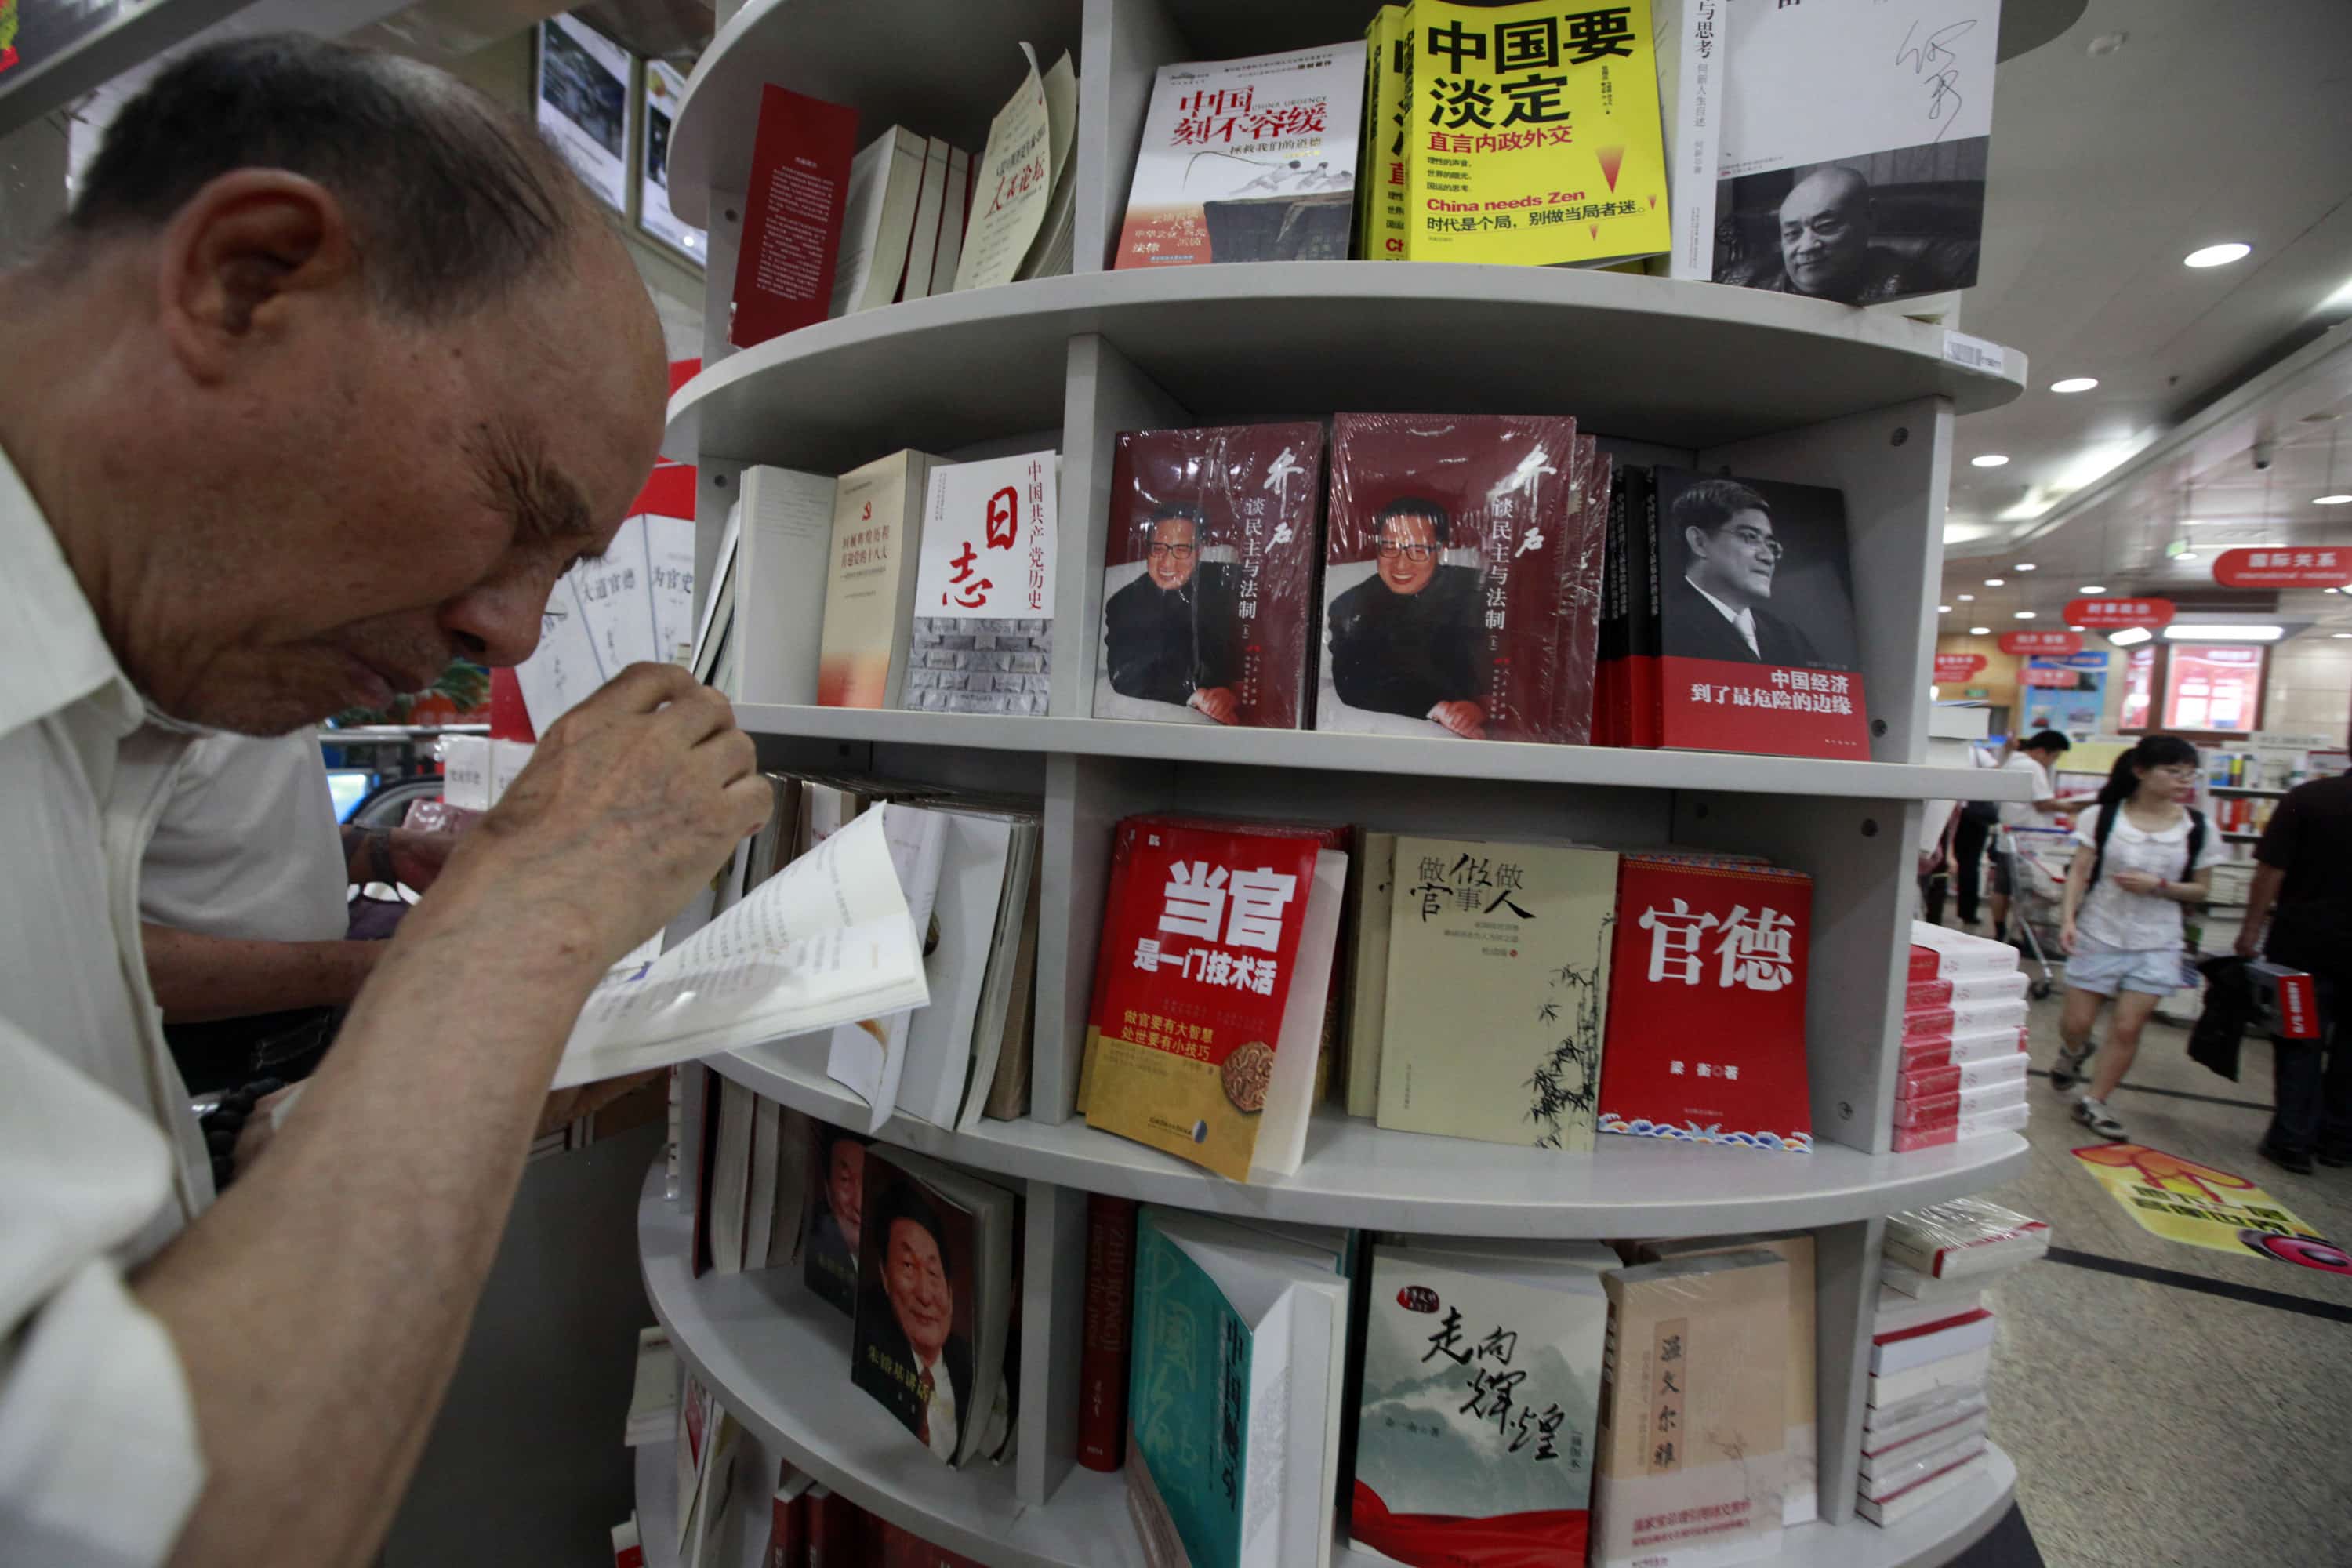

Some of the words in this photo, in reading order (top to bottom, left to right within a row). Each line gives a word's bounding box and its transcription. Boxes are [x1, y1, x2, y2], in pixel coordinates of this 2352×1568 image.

[1428, 8, 1635, 74] 中国要
[1169, 101, 1328, 147] 刻不容缓
[1179, 85, 1254, 118] 中国
[1429, 74, 1571, 129] 淡定
[1229, 137, 1322, 155] 拯救我们的道德
[1427, 125, 1573, 154] 直言内政外交
[1427, 198, 1479, 212] China
[1488, 194, 1543, 211] needs
[1548, 189, 1585, 205] Zen
[1427, 199, 1646, 233] 时代是个局，别做当局者迷。
[942, 485, 1018, 609] 日志
[1029, 459, 1044, 610] 中国共产党历史
[1238, 498, 1265, 619] 谈民主与法制
[1485, 499, 1514, 630] 谈民主与法制
[1690, 683, 1853, 715] 到了最危险的边缘
[1771, 669, 1849, 695] 中国经济
[1158, 860, 1297, 952] 当官
[1133, 938, 1278, 996] 是一门技术活
[1639, 898, 1796, 992] 官德
[1122, 1026, 1211, 1061] 处世要有小技巧
[1123, 1009, 1214, 1044] 做官要有大智慧
[1421, 1306, 1519, 1367] 走向
[1460, 1368, 1566, 1461] 辉煌
